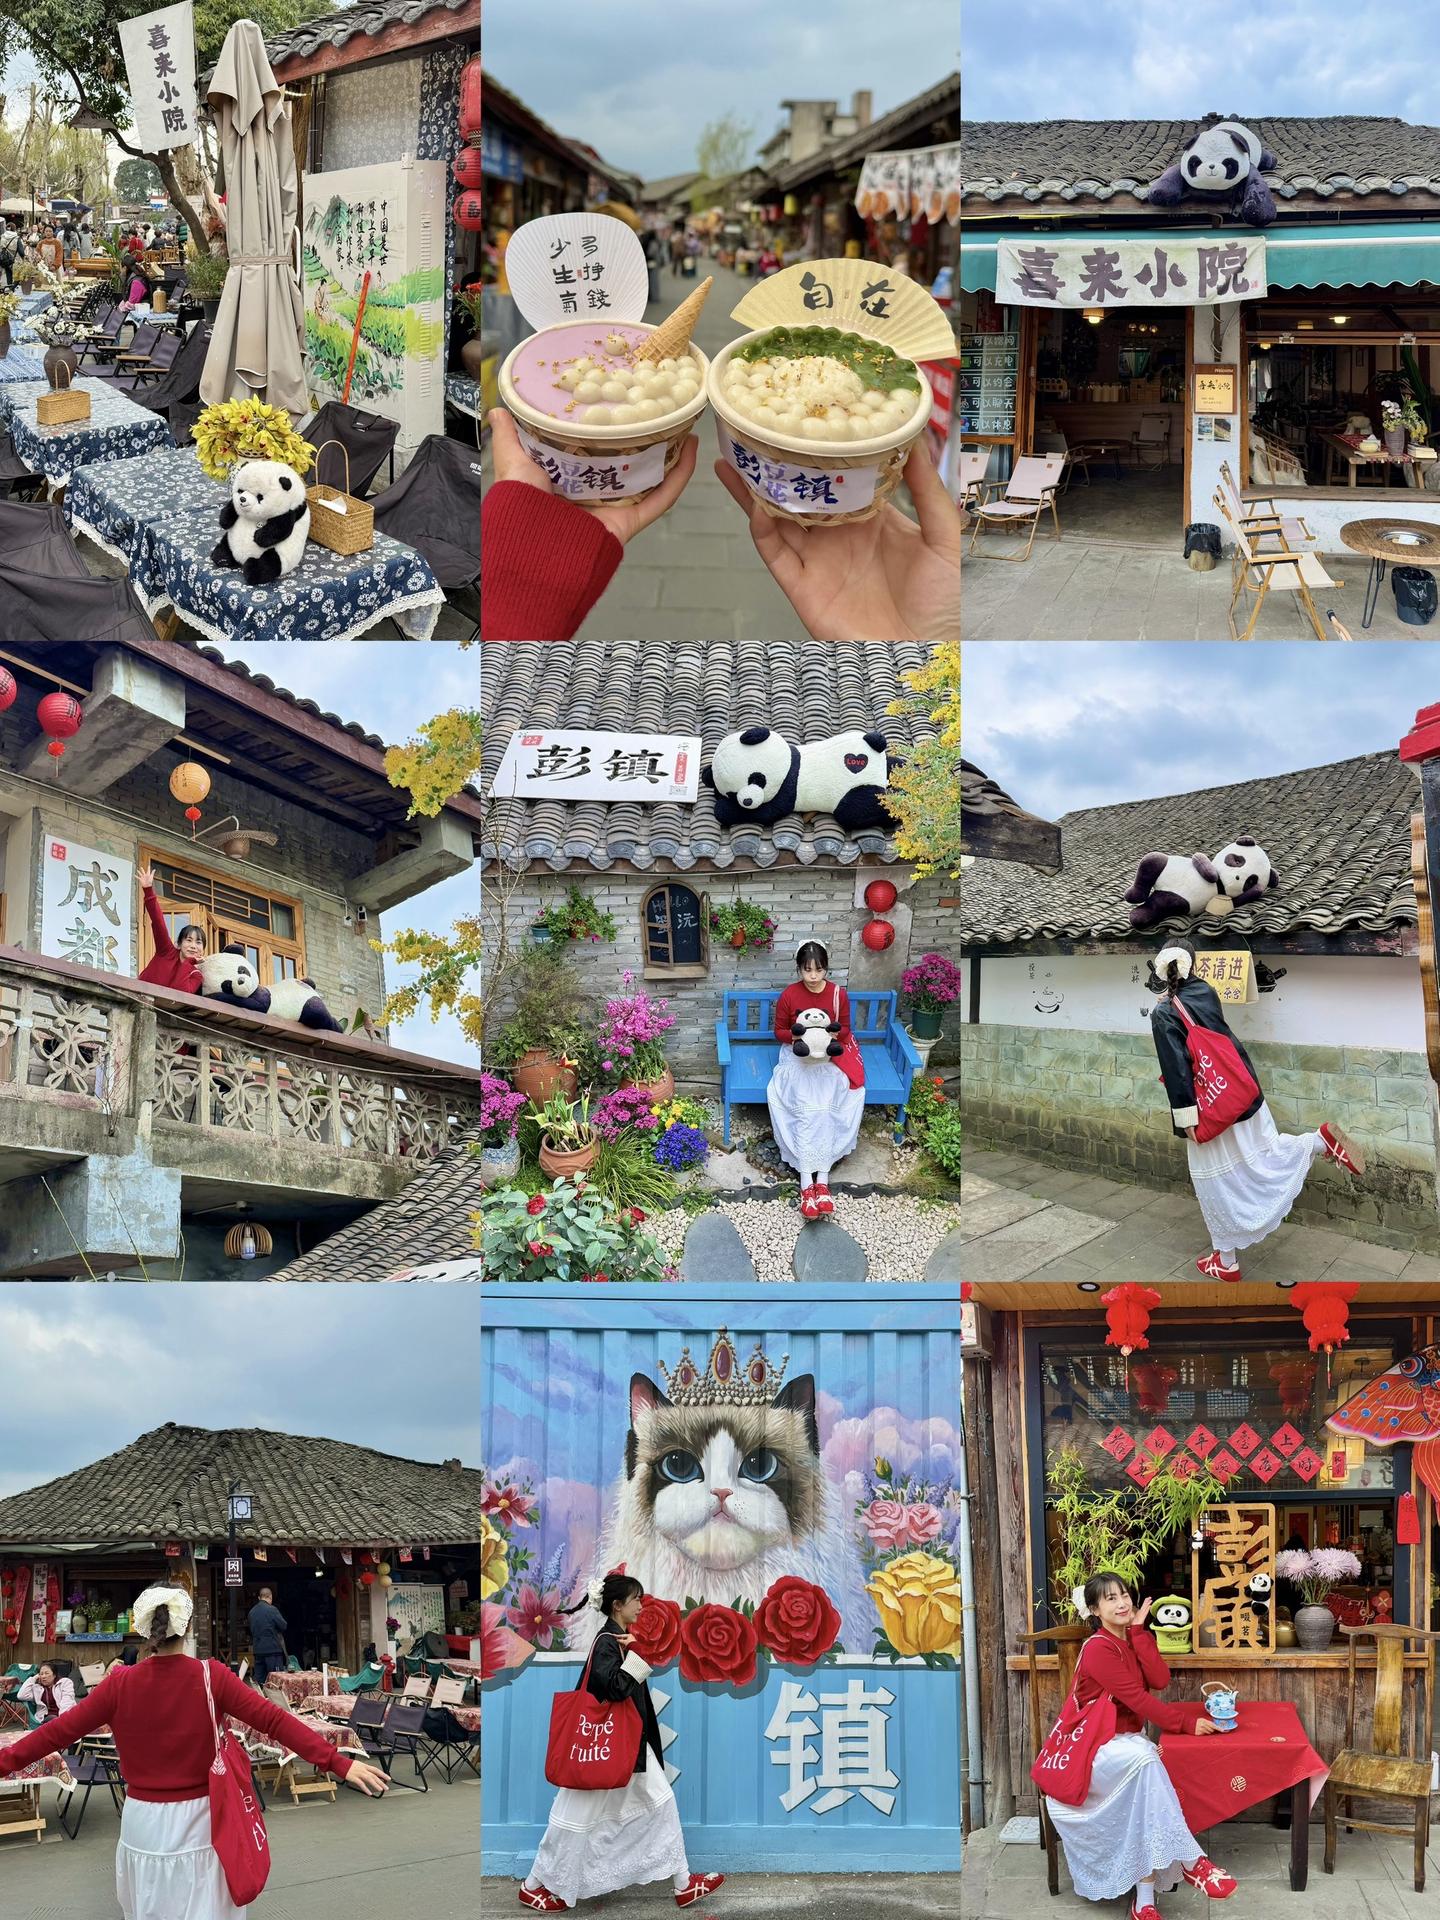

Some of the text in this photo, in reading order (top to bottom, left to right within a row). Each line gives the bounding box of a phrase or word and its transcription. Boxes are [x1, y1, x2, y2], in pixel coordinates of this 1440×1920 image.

[147, 24, 188, 134] 喜来小院
[1010, 241, 1250, 304] 喜来小院
[526, 744, 669, 785] 彭镇
[57, 861, 121, 972] 成都
[1194, 956, 1243, 980] 茶请进
